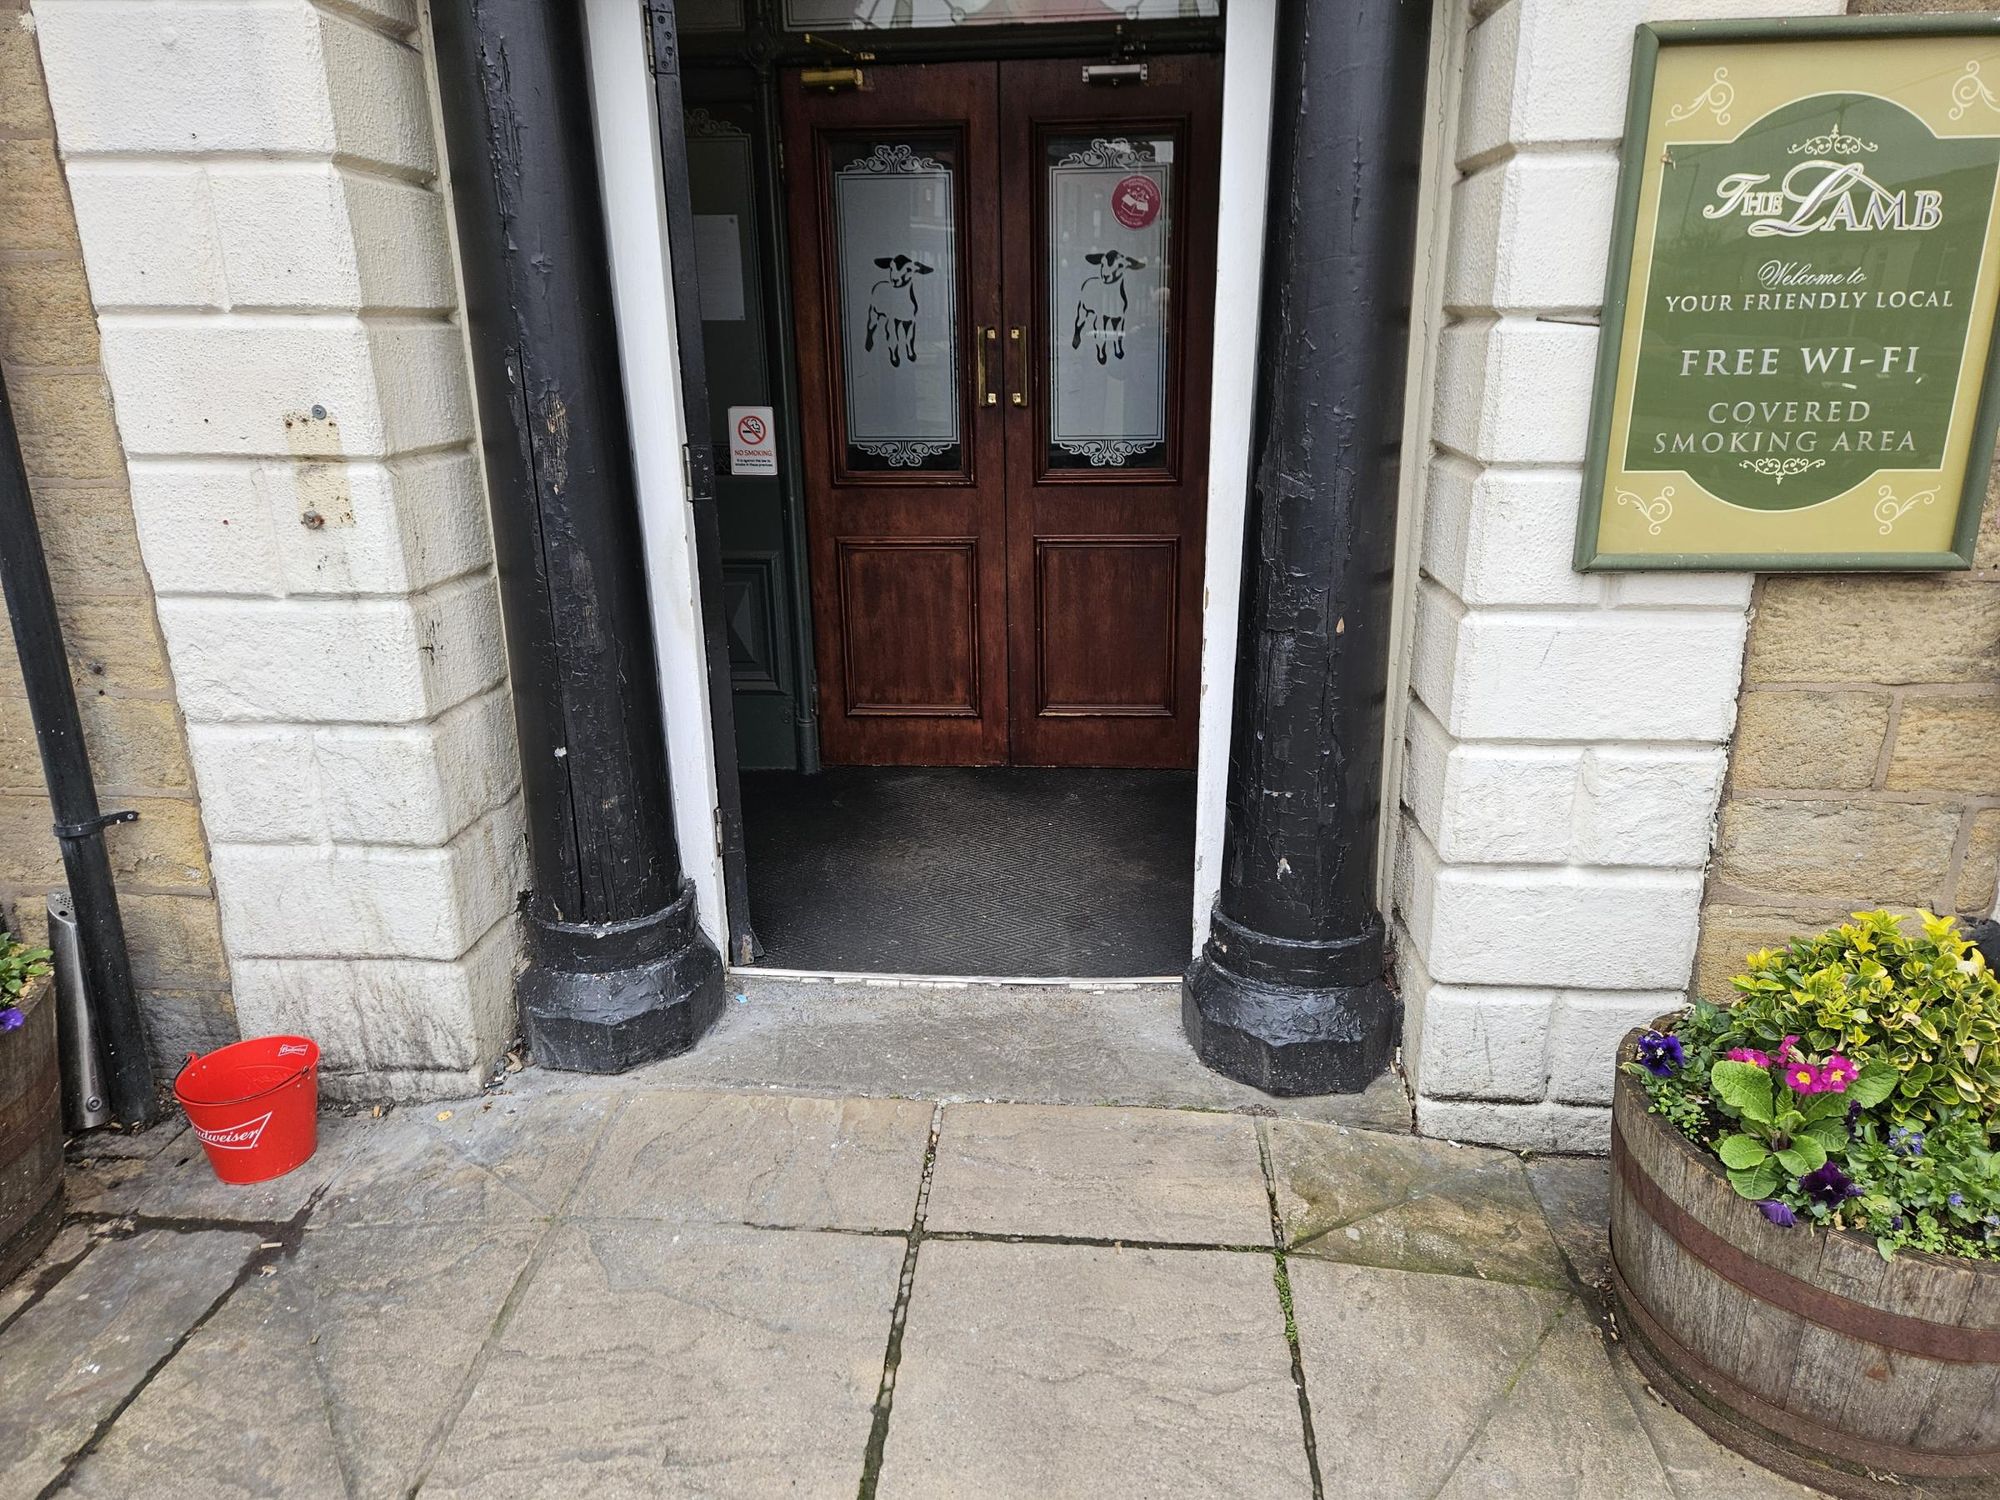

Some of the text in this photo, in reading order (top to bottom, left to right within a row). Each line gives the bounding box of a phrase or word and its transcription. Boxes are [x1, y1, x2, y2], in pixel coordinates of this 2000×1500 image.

[1748, 160, 1942, 237] LAMB
[1758, 260, 1867, 290] Welcome to
[1666, 290, 1953, 312] YOUR FRIENDLY LOCAL
[1680, 346, 1920, 376] FREE WI-FI
[1708, 401, 1871, 423] COVERED
[1654, 430, 1916, 453] SMOKING AREA
